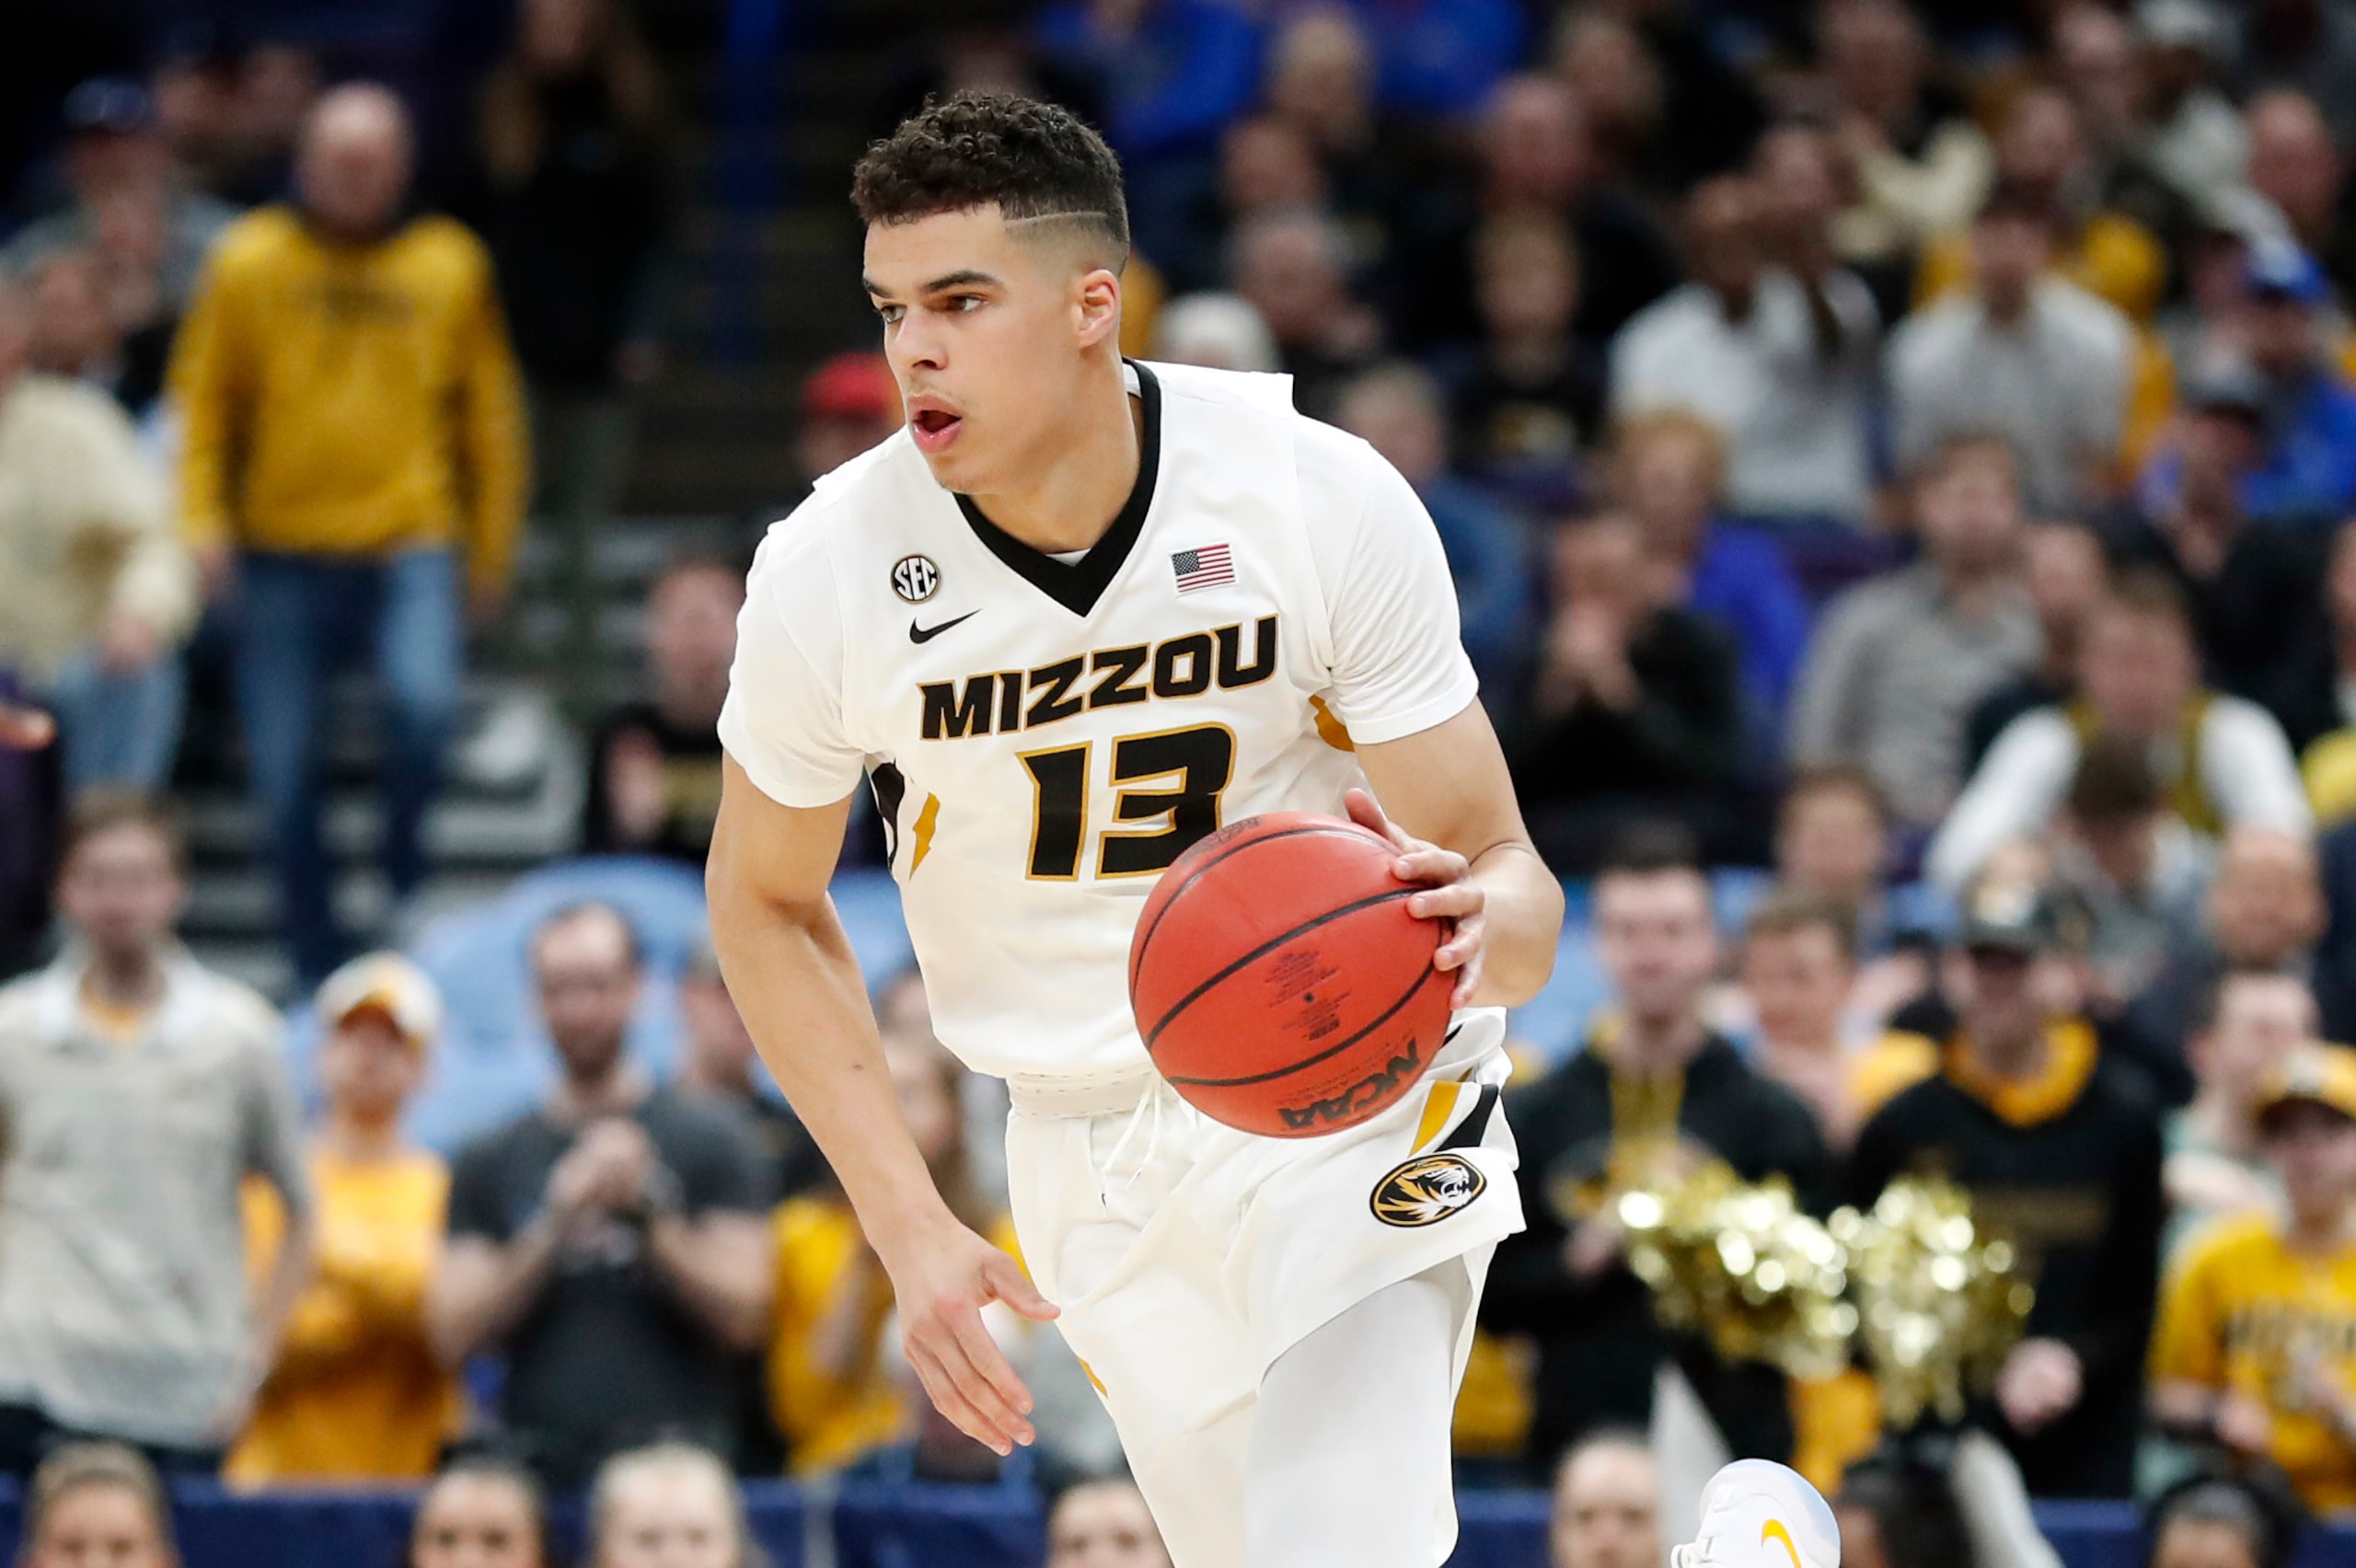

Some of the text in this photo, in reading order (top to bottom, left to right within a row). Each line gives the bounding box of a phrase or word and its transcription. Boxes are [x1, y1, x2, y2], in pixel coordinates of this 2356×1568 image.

[895, 558, 937, 600] SEC
[917, 613, 1278, 741] MIZZOU
[1015, 721, 1237, 882] 13
[1277, 1037, 1421, 1129] NCAA
